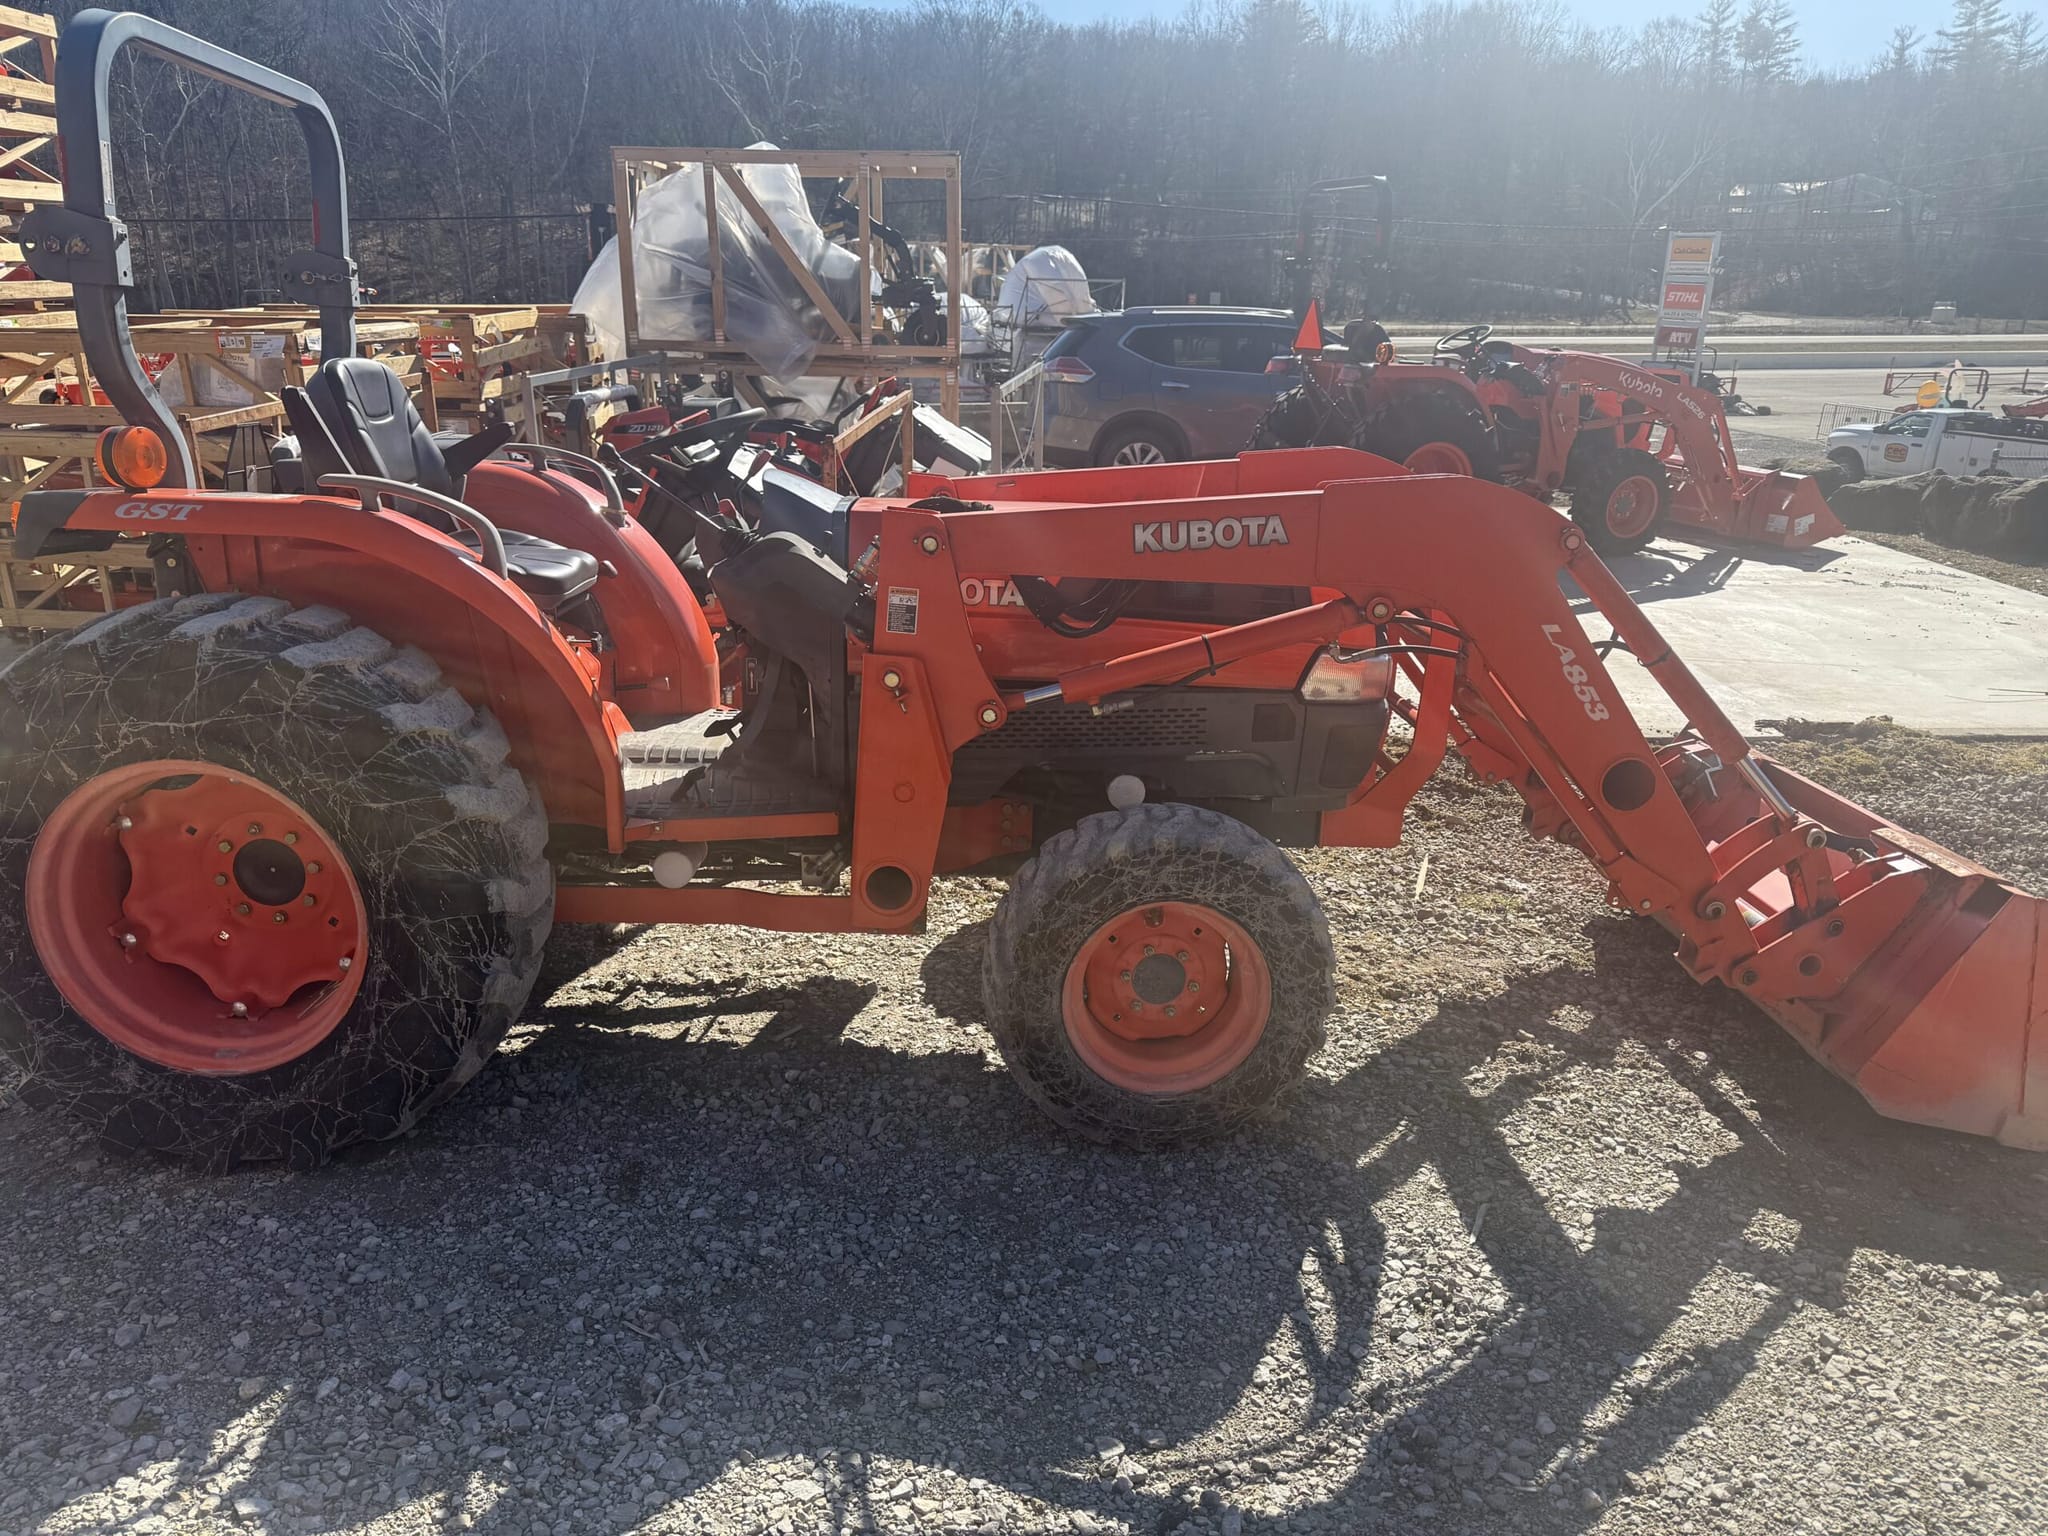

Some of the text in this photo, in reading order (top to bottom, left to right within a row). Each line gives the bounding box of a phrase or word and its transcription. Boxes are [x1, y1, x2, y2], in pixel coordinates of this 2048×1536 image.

[1666, 291, 1699, 303] STIHL
[1619, 371, 1663, 398] Kubota
[1676, 392, 1706, 420] LA526
[114, 502, 203, 521] GST
[1133, 514, 1289, 553] KUBOTA
[1541, 624, 1610, 721] LA853
